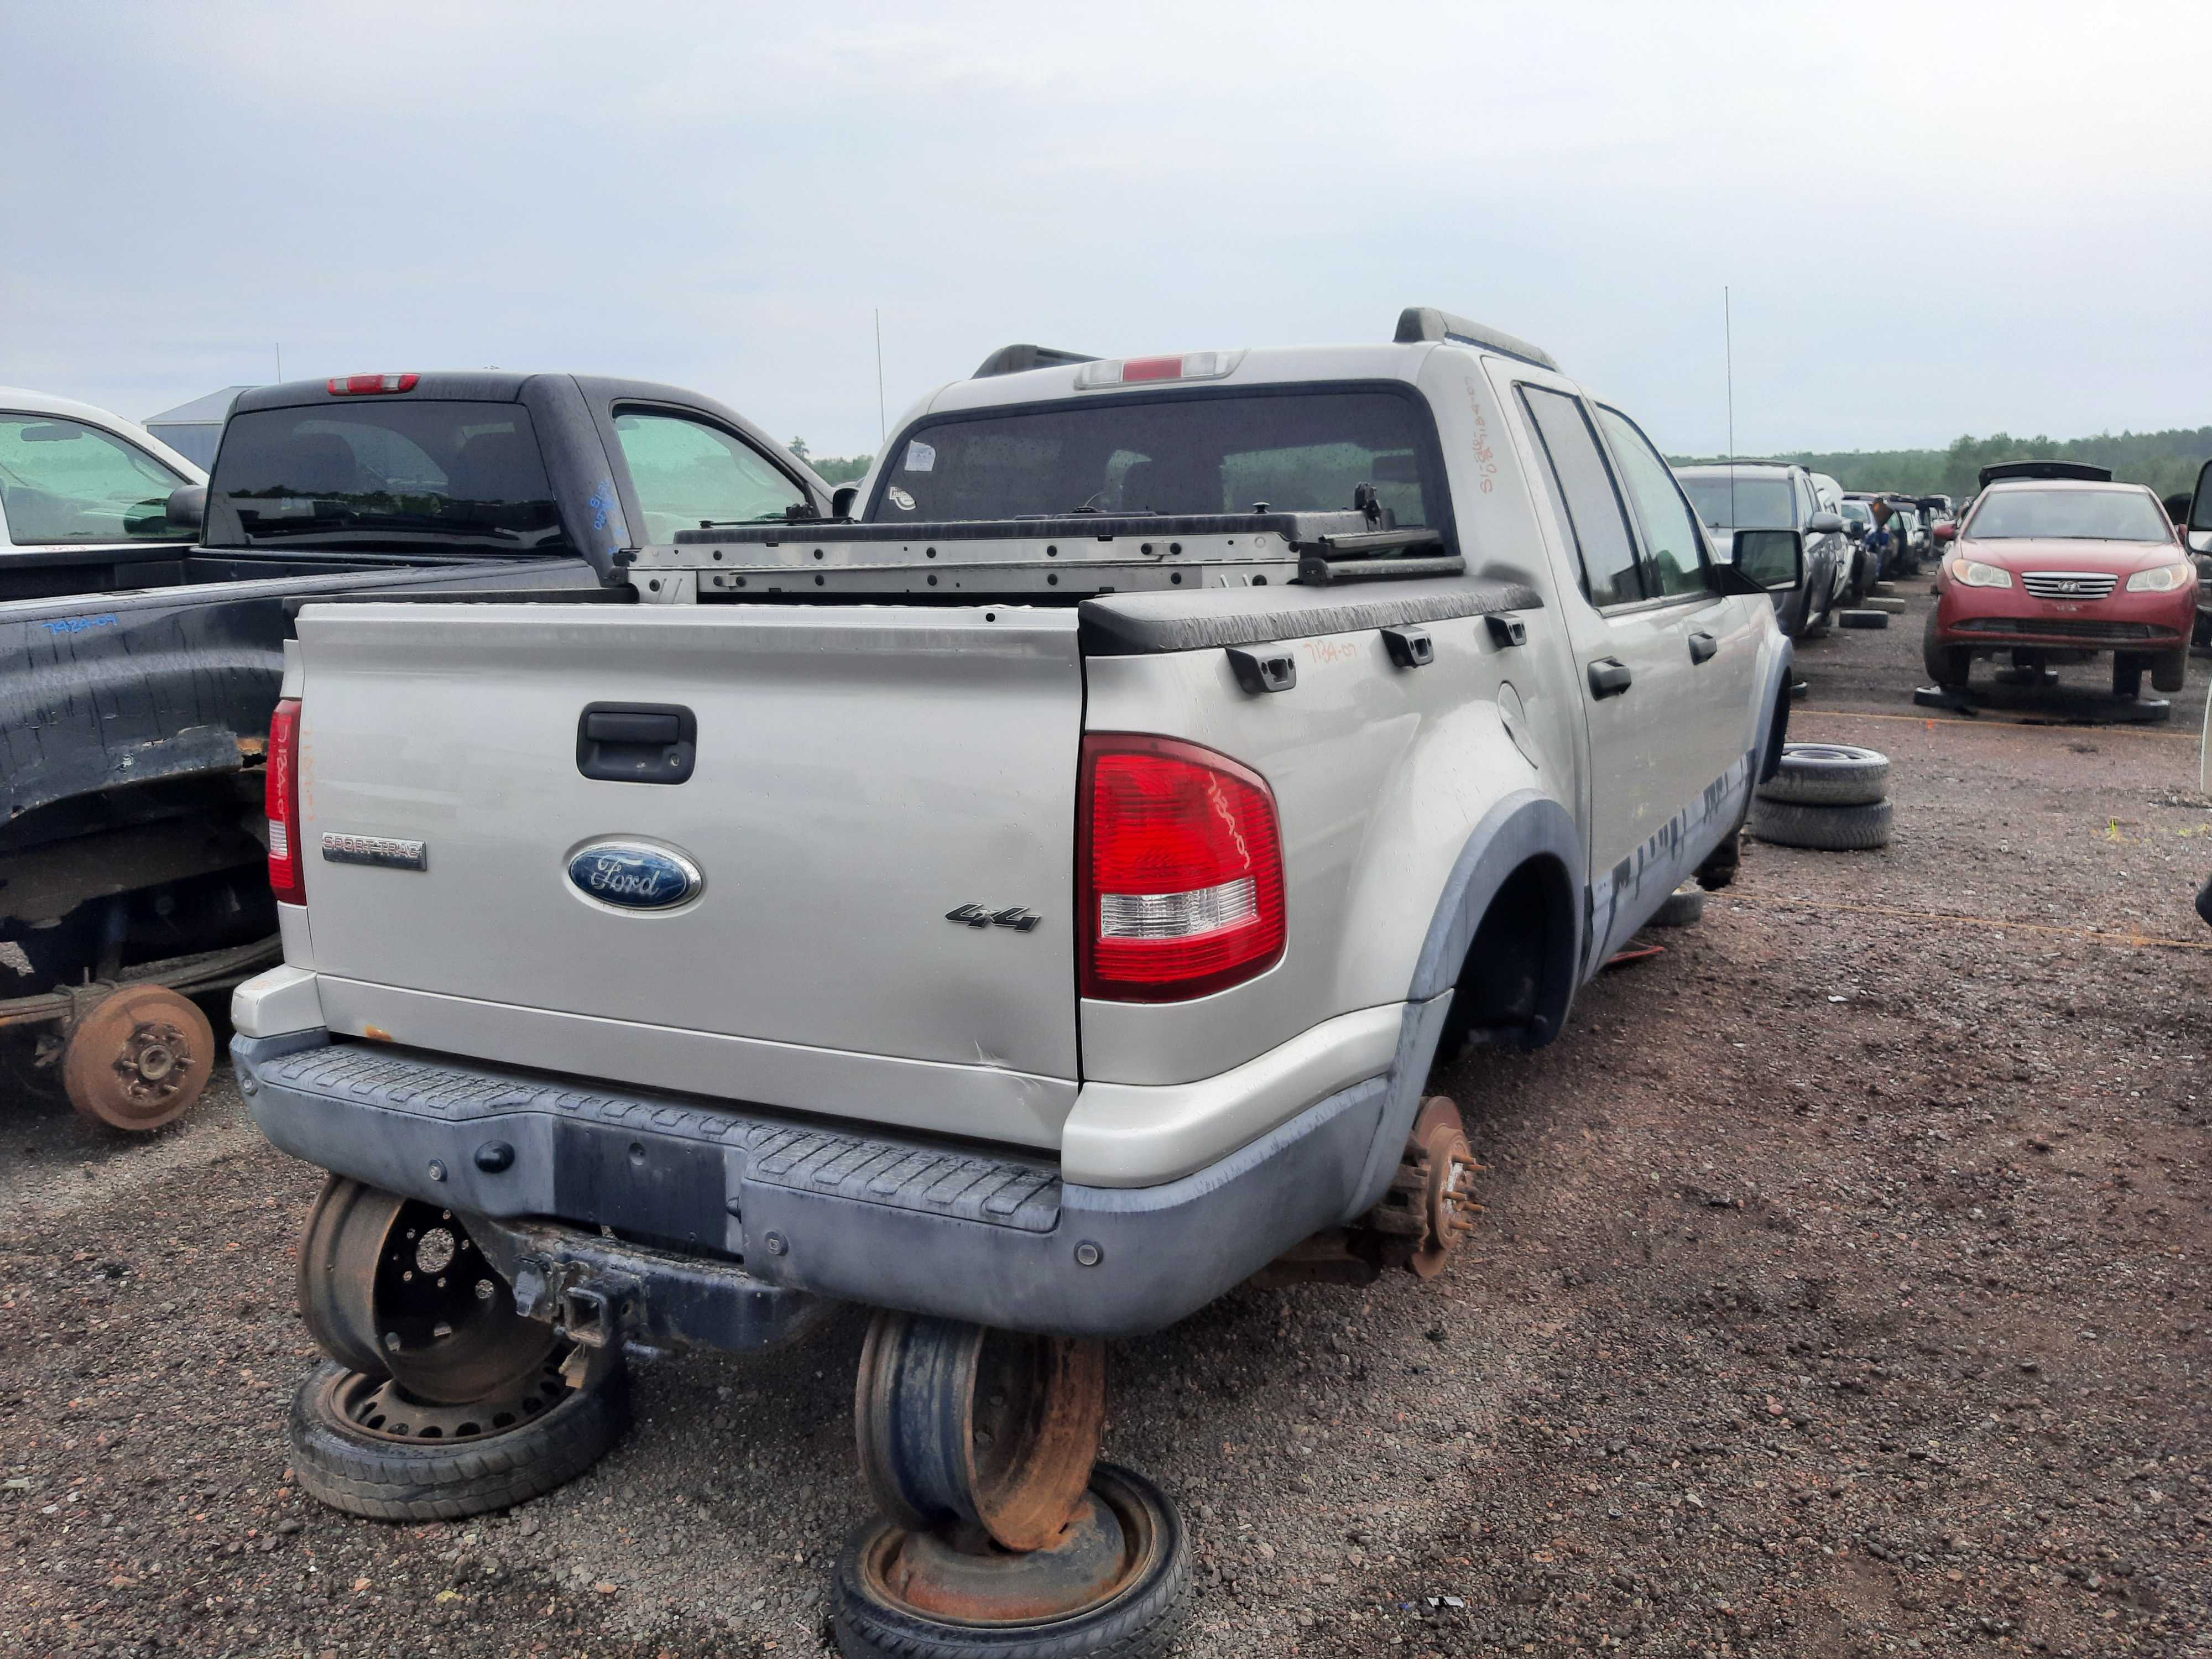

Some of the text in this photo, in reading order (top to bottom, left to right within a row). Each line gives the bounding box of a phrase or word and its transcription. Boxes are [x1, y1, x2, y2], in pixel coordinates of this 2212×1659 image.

[322, 834, 421, 859] SPORT TRAC
[591, 855, 660, 895] Ford
